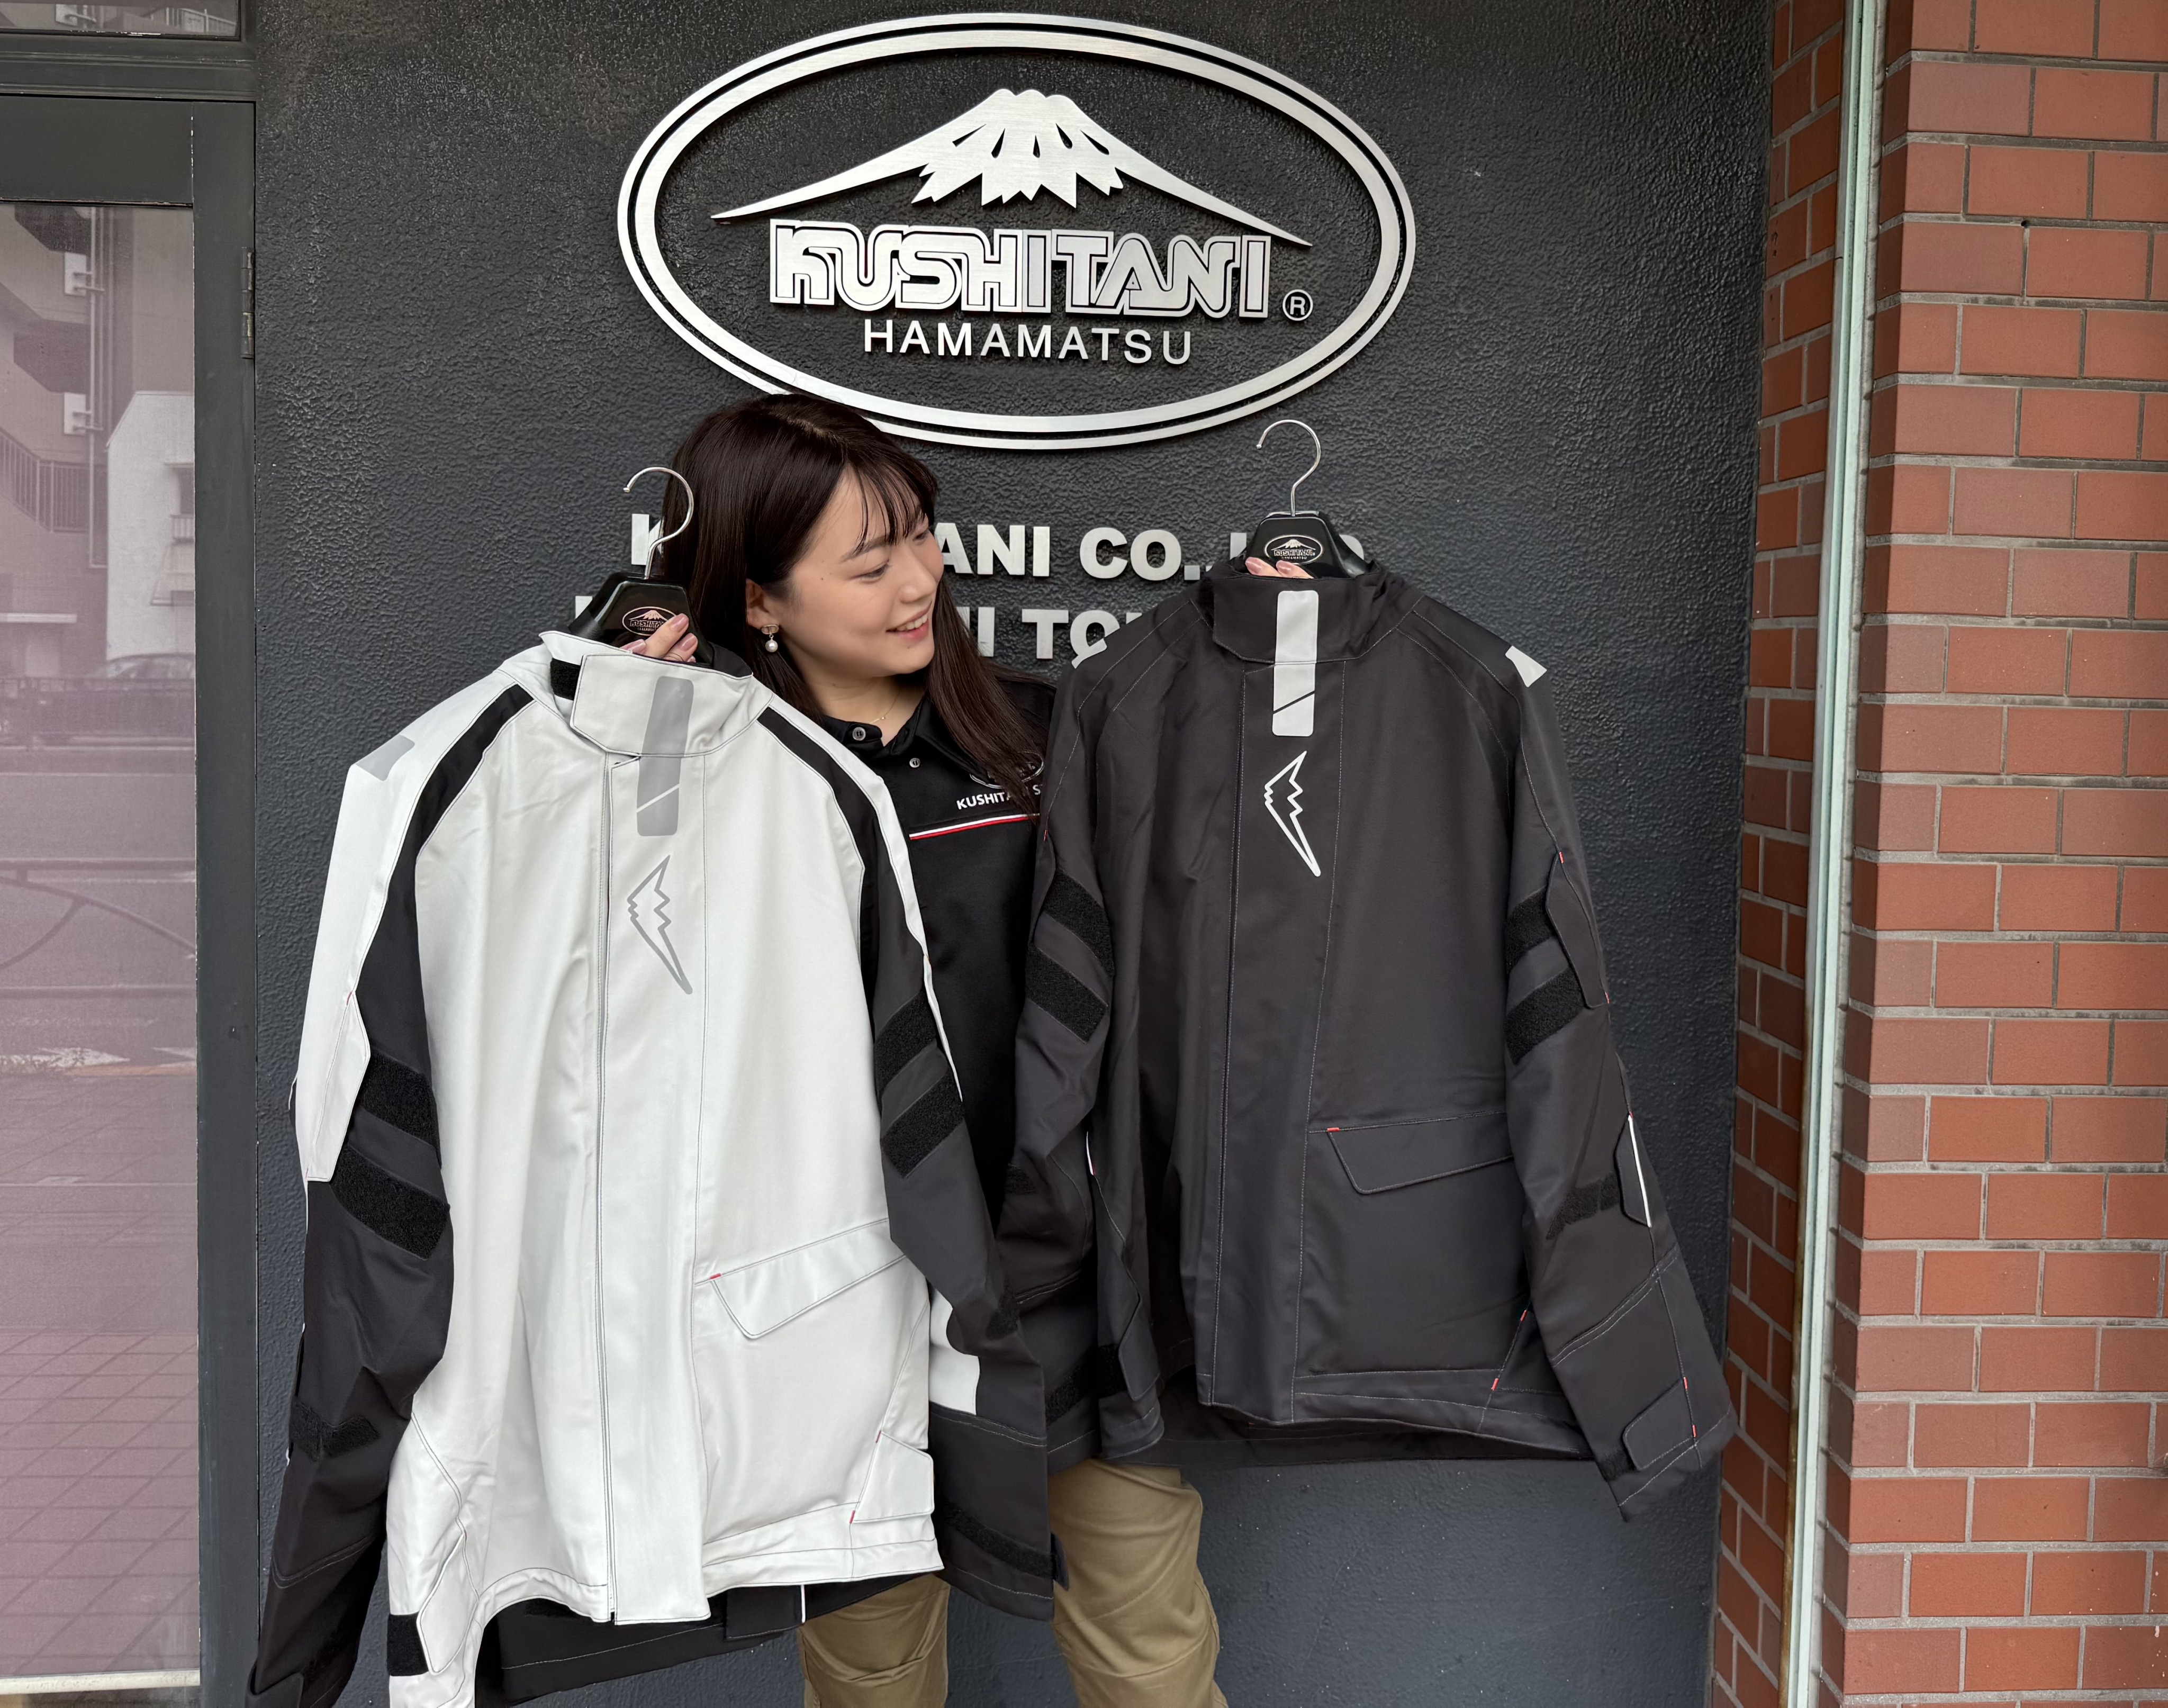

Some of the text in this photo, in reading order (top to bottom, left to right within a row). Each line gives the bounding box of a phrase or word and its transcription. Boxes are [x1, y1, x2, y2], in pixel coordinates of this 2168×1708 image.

[770, 219, 1271, 318] KUSHITANI
[864, 319, 1191, 365] HAMAMATSU
[1080, 527, 1213, 580] CO.
[956, 792, 1011, 810] KUSHIT
